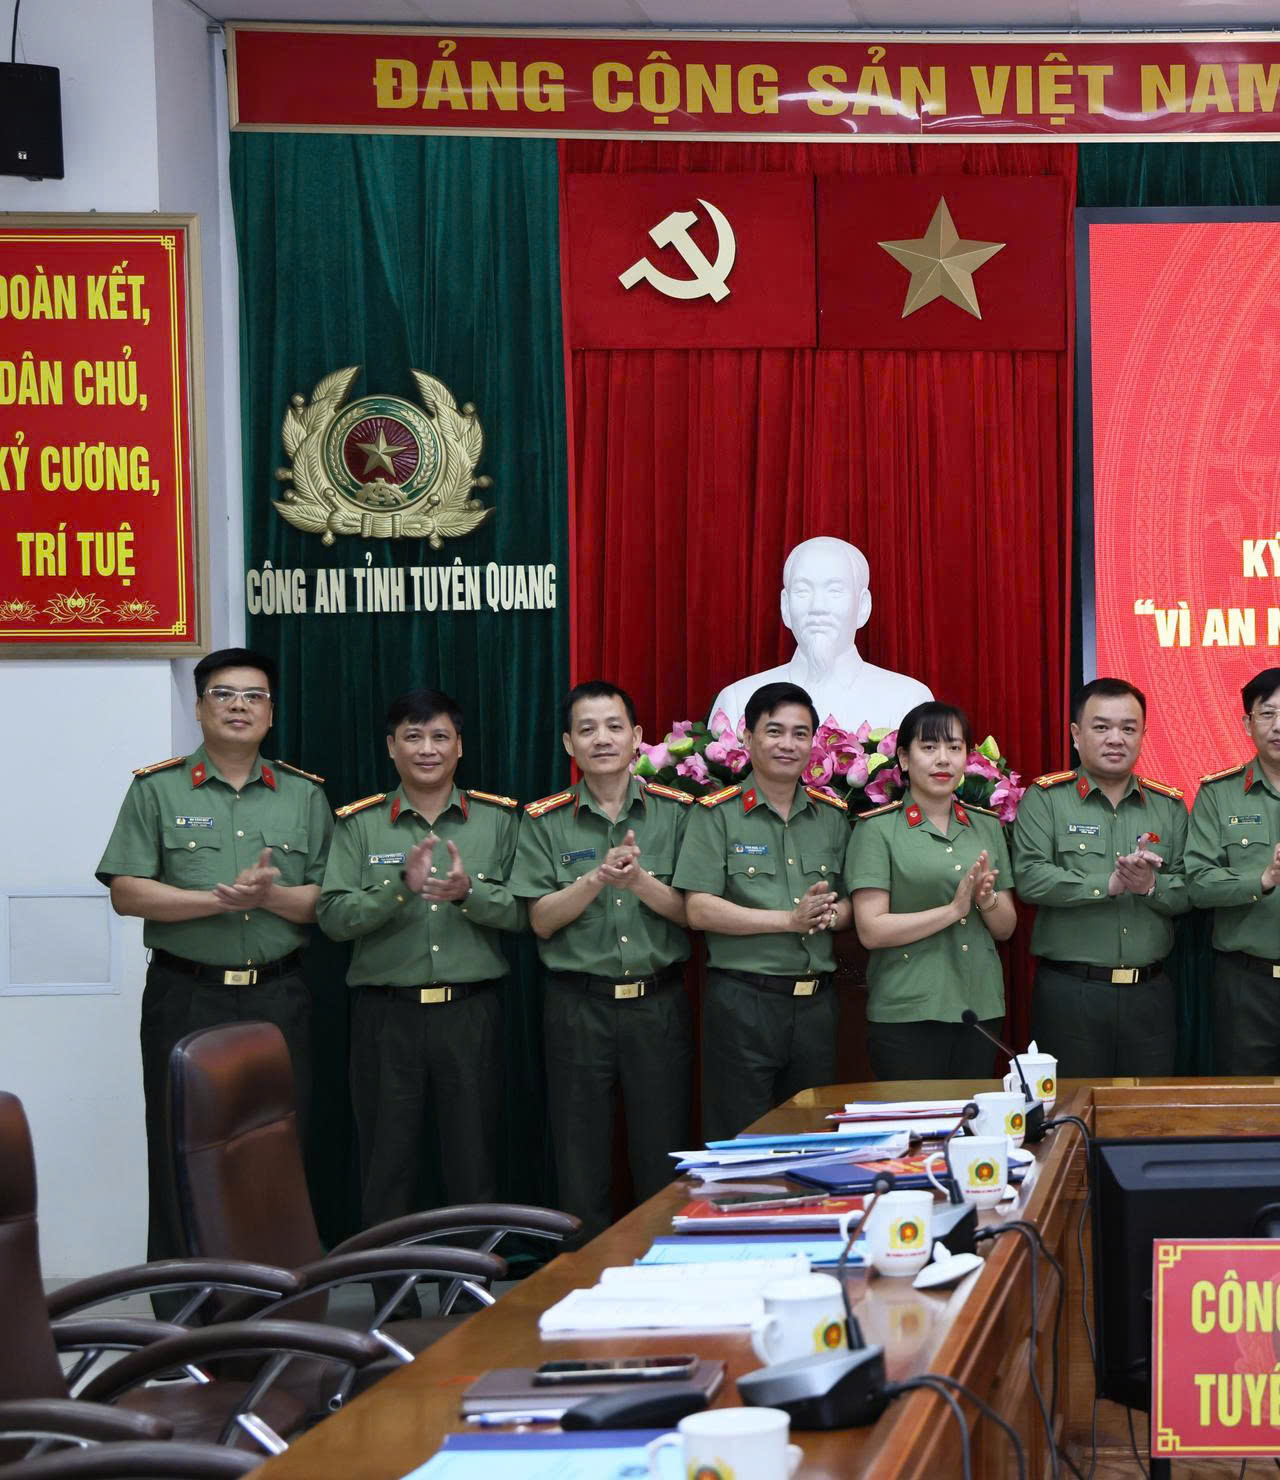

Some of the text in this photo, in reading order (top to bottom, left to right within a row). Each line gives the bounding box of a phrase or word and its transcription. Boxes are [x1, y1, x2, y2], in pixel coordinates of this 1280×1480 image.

[372, 40, 566, 112] ĐẢNG
[592, 51, 779, 124] CỘNG
[807, 46, 946, 116] SẢN
[971, 53, 1112, 126] VIỆT
[88, 261, 149, 325] KẾT,
[0, 346, 147, 411] DÂN CHỦ,
[41, 442, 159, 496] CƯƠNG,
[17, 523, 135, 586] TRÍ TUỆ
[247, 552, 556, 614] CÔNG AN TỈNH TUYÊN QUANG
[1202, 608, 1255, 646] AN
